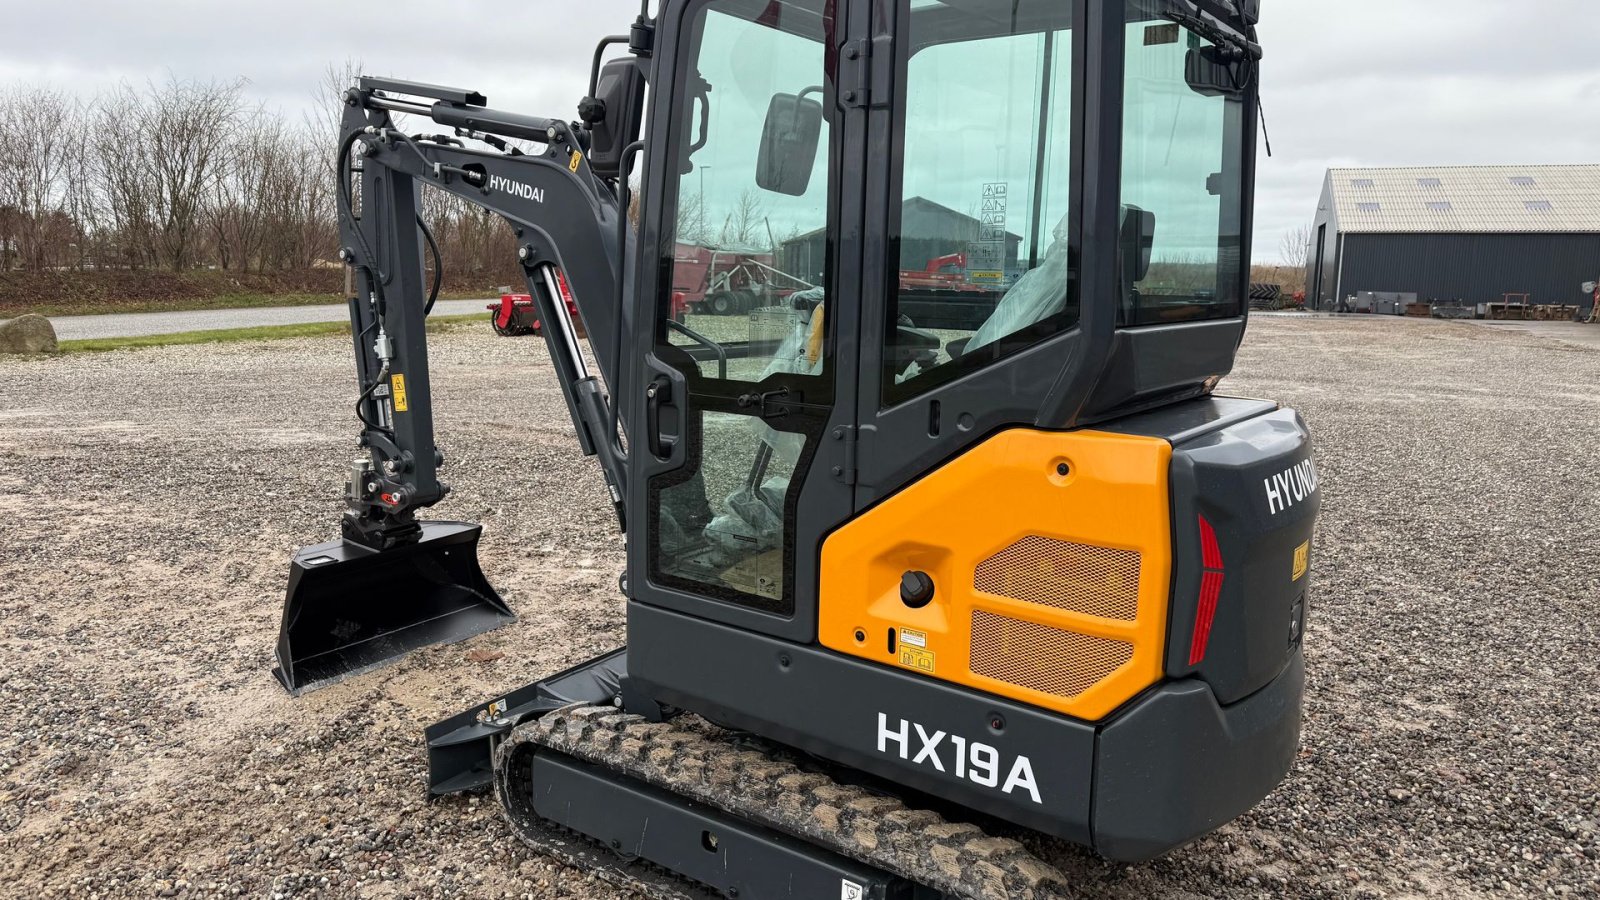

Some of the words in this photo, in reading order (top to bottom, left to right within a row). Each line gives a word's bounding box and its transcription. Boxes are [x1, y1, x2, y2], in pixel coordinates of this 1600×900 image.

[490, 174, 544, 203] HYUNDAI
[1264, 455, 1318, 515] HYUNDA
[877, 712, 1042, 804] HX19A
